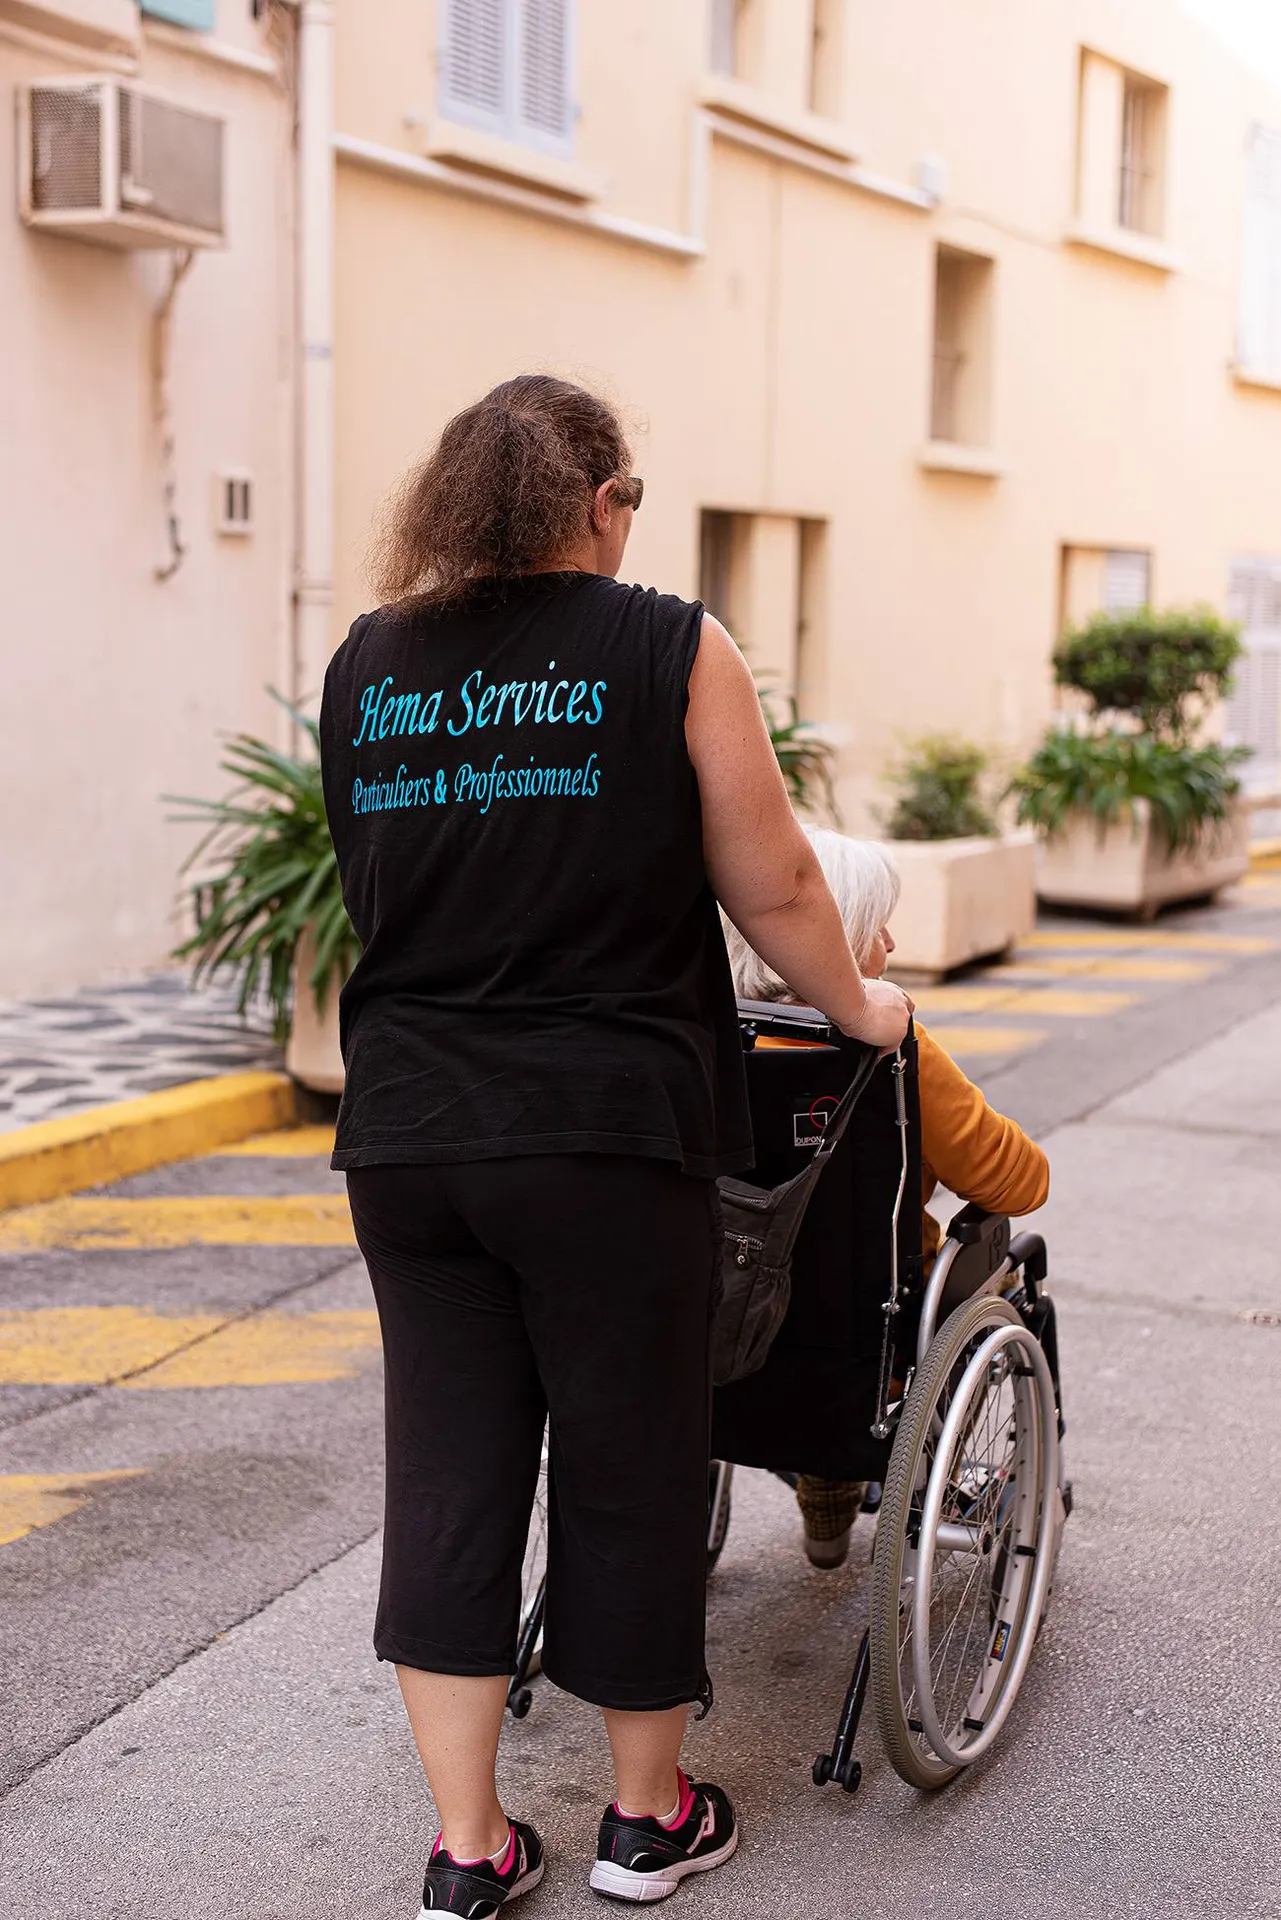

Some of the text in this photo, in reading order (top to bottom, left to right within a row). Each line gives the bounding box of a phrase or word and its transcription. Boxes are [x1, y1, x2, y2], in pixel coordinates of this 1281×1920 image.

[352, 660, 608, 747] Hema Services
[352, 752, 602, 815] Particuliers & Professionnels
[796, 1136, 822, 1145] DUPON
